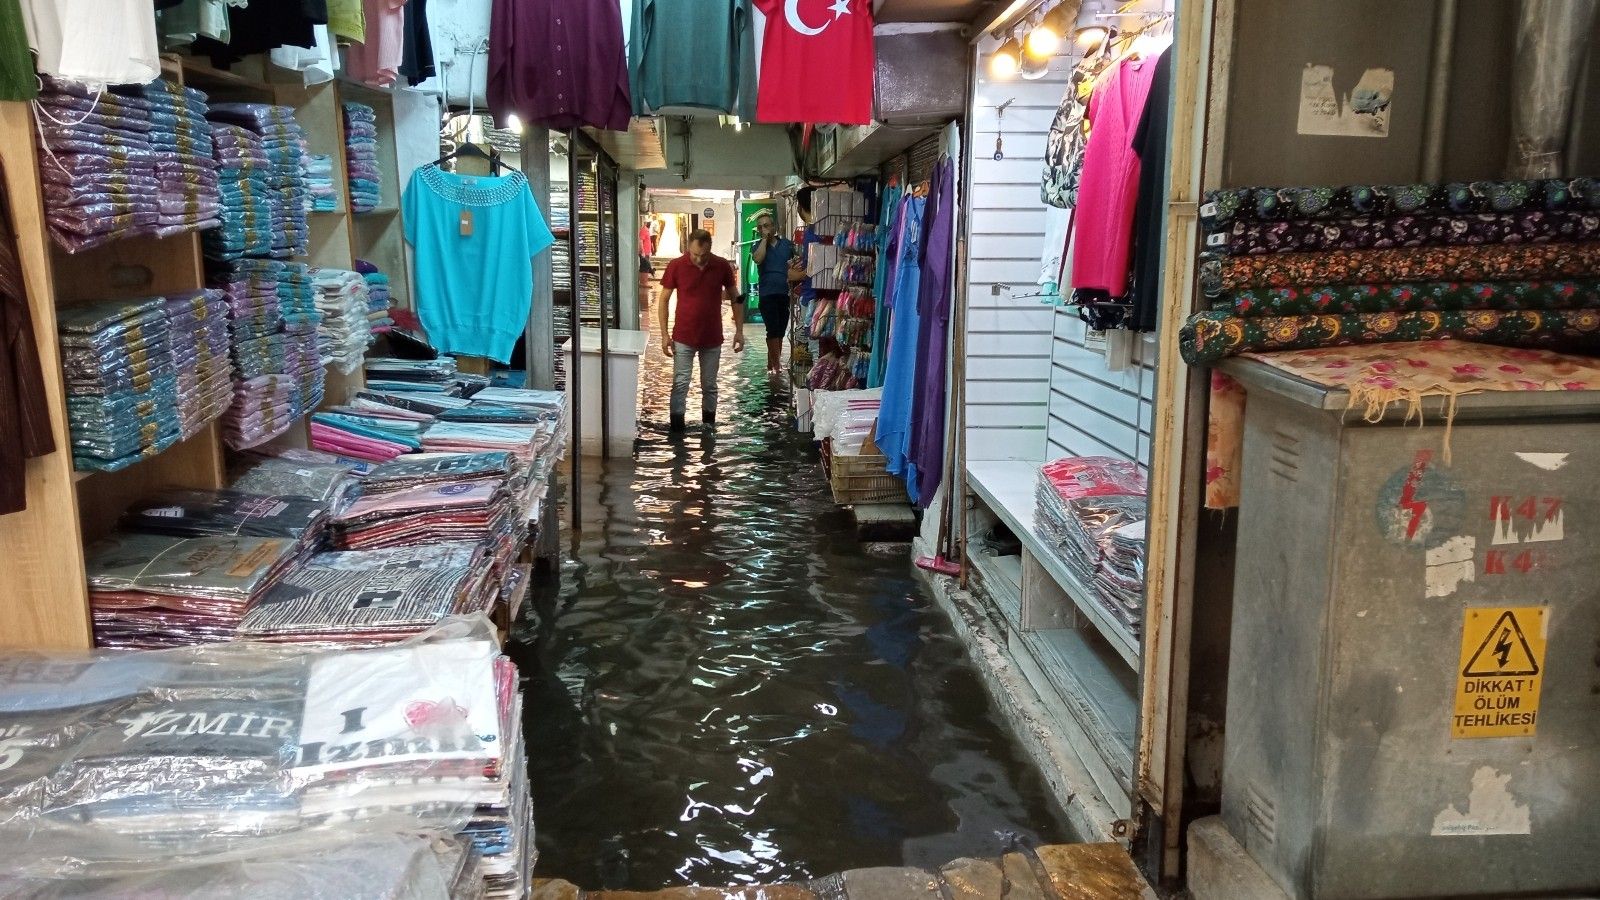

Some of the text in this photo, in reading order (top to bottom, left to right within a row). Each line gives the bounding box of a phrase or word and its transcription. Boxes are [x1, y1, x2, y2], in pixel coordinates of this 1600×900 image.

[1490, 495, 1563, 521] K47
[1464, 678, 1525, 694] DİKKAT
[1473, 695, 1521, 710] ÖLÜM
[339, 706, 368, 735] I
[1454, 710, 1537, 727] TEHLİKESİ
